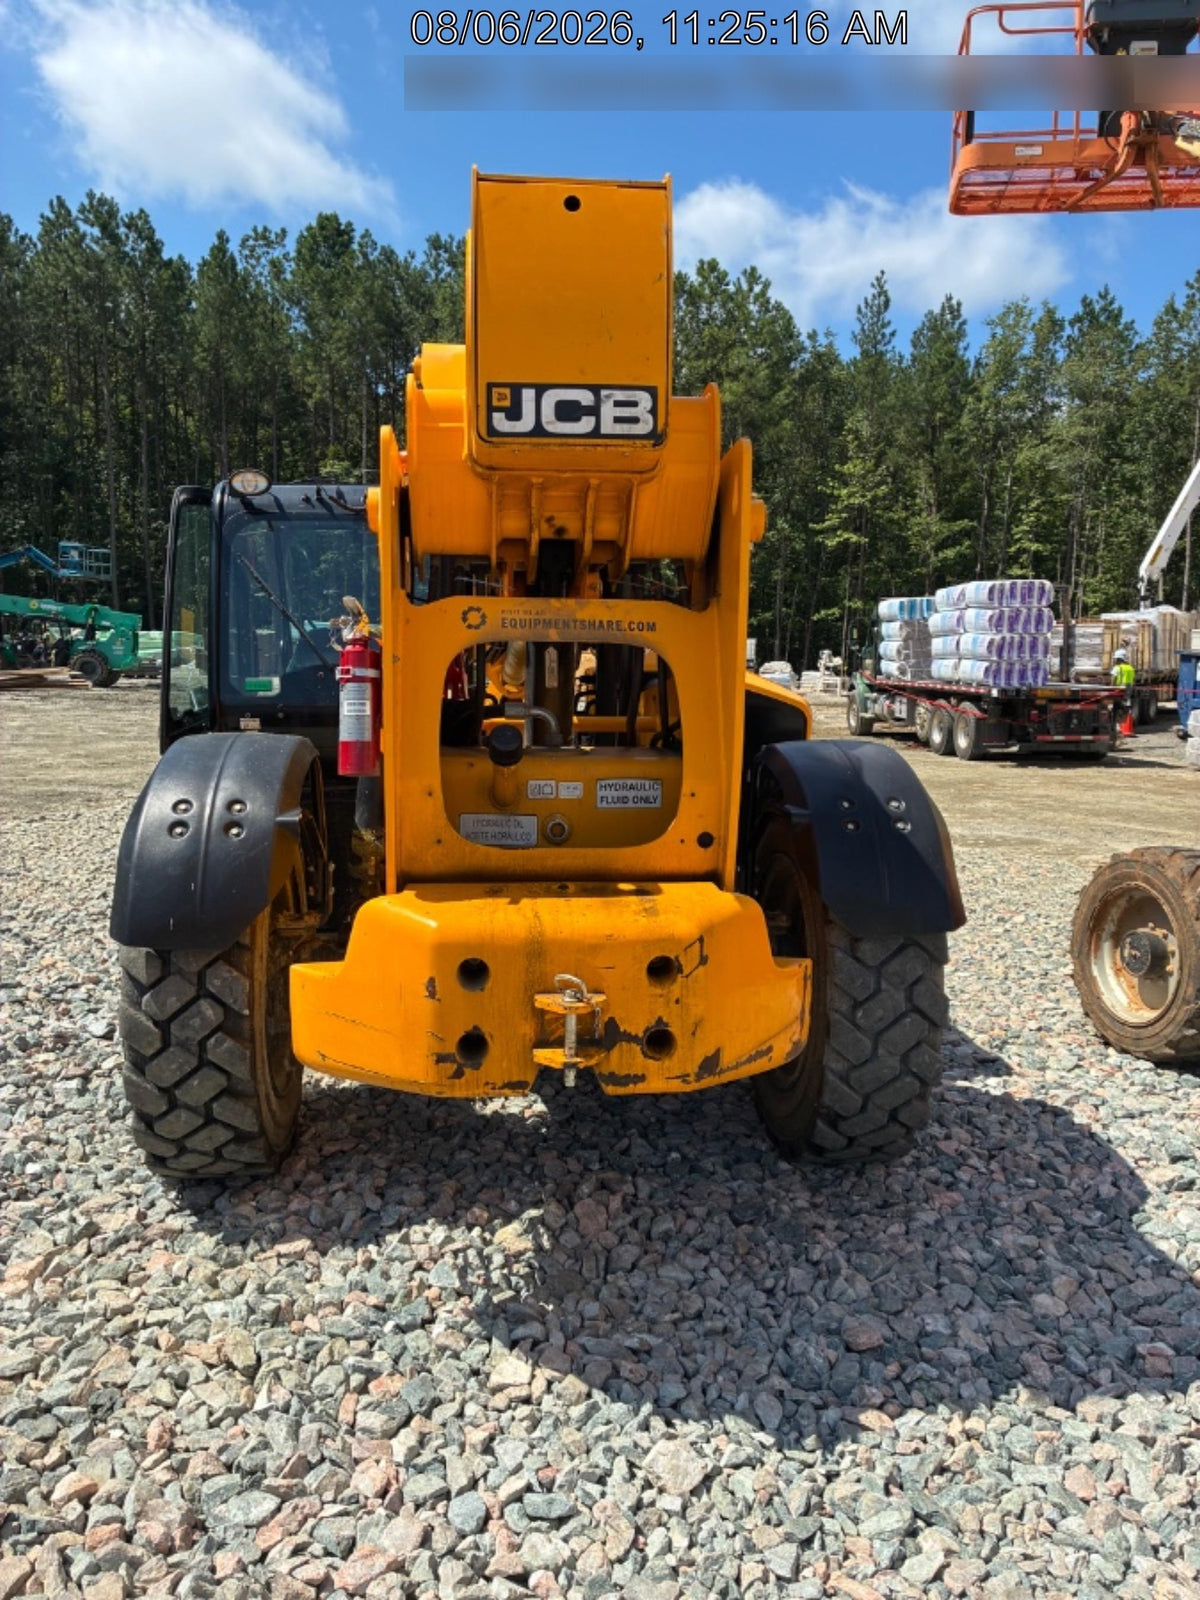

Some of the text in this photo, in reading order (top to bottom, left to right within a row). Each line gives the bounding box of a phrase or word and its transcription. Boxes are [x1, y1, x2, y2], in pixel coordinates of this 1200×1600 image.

[492, 388, 654, 435] JCB
[501, 617, 657, 632] EQUIPMENTSHARE.COM
[599, 782, 660, 792] HYDRAULIC
[600, 795, 659, 805] FLUID ONLY
